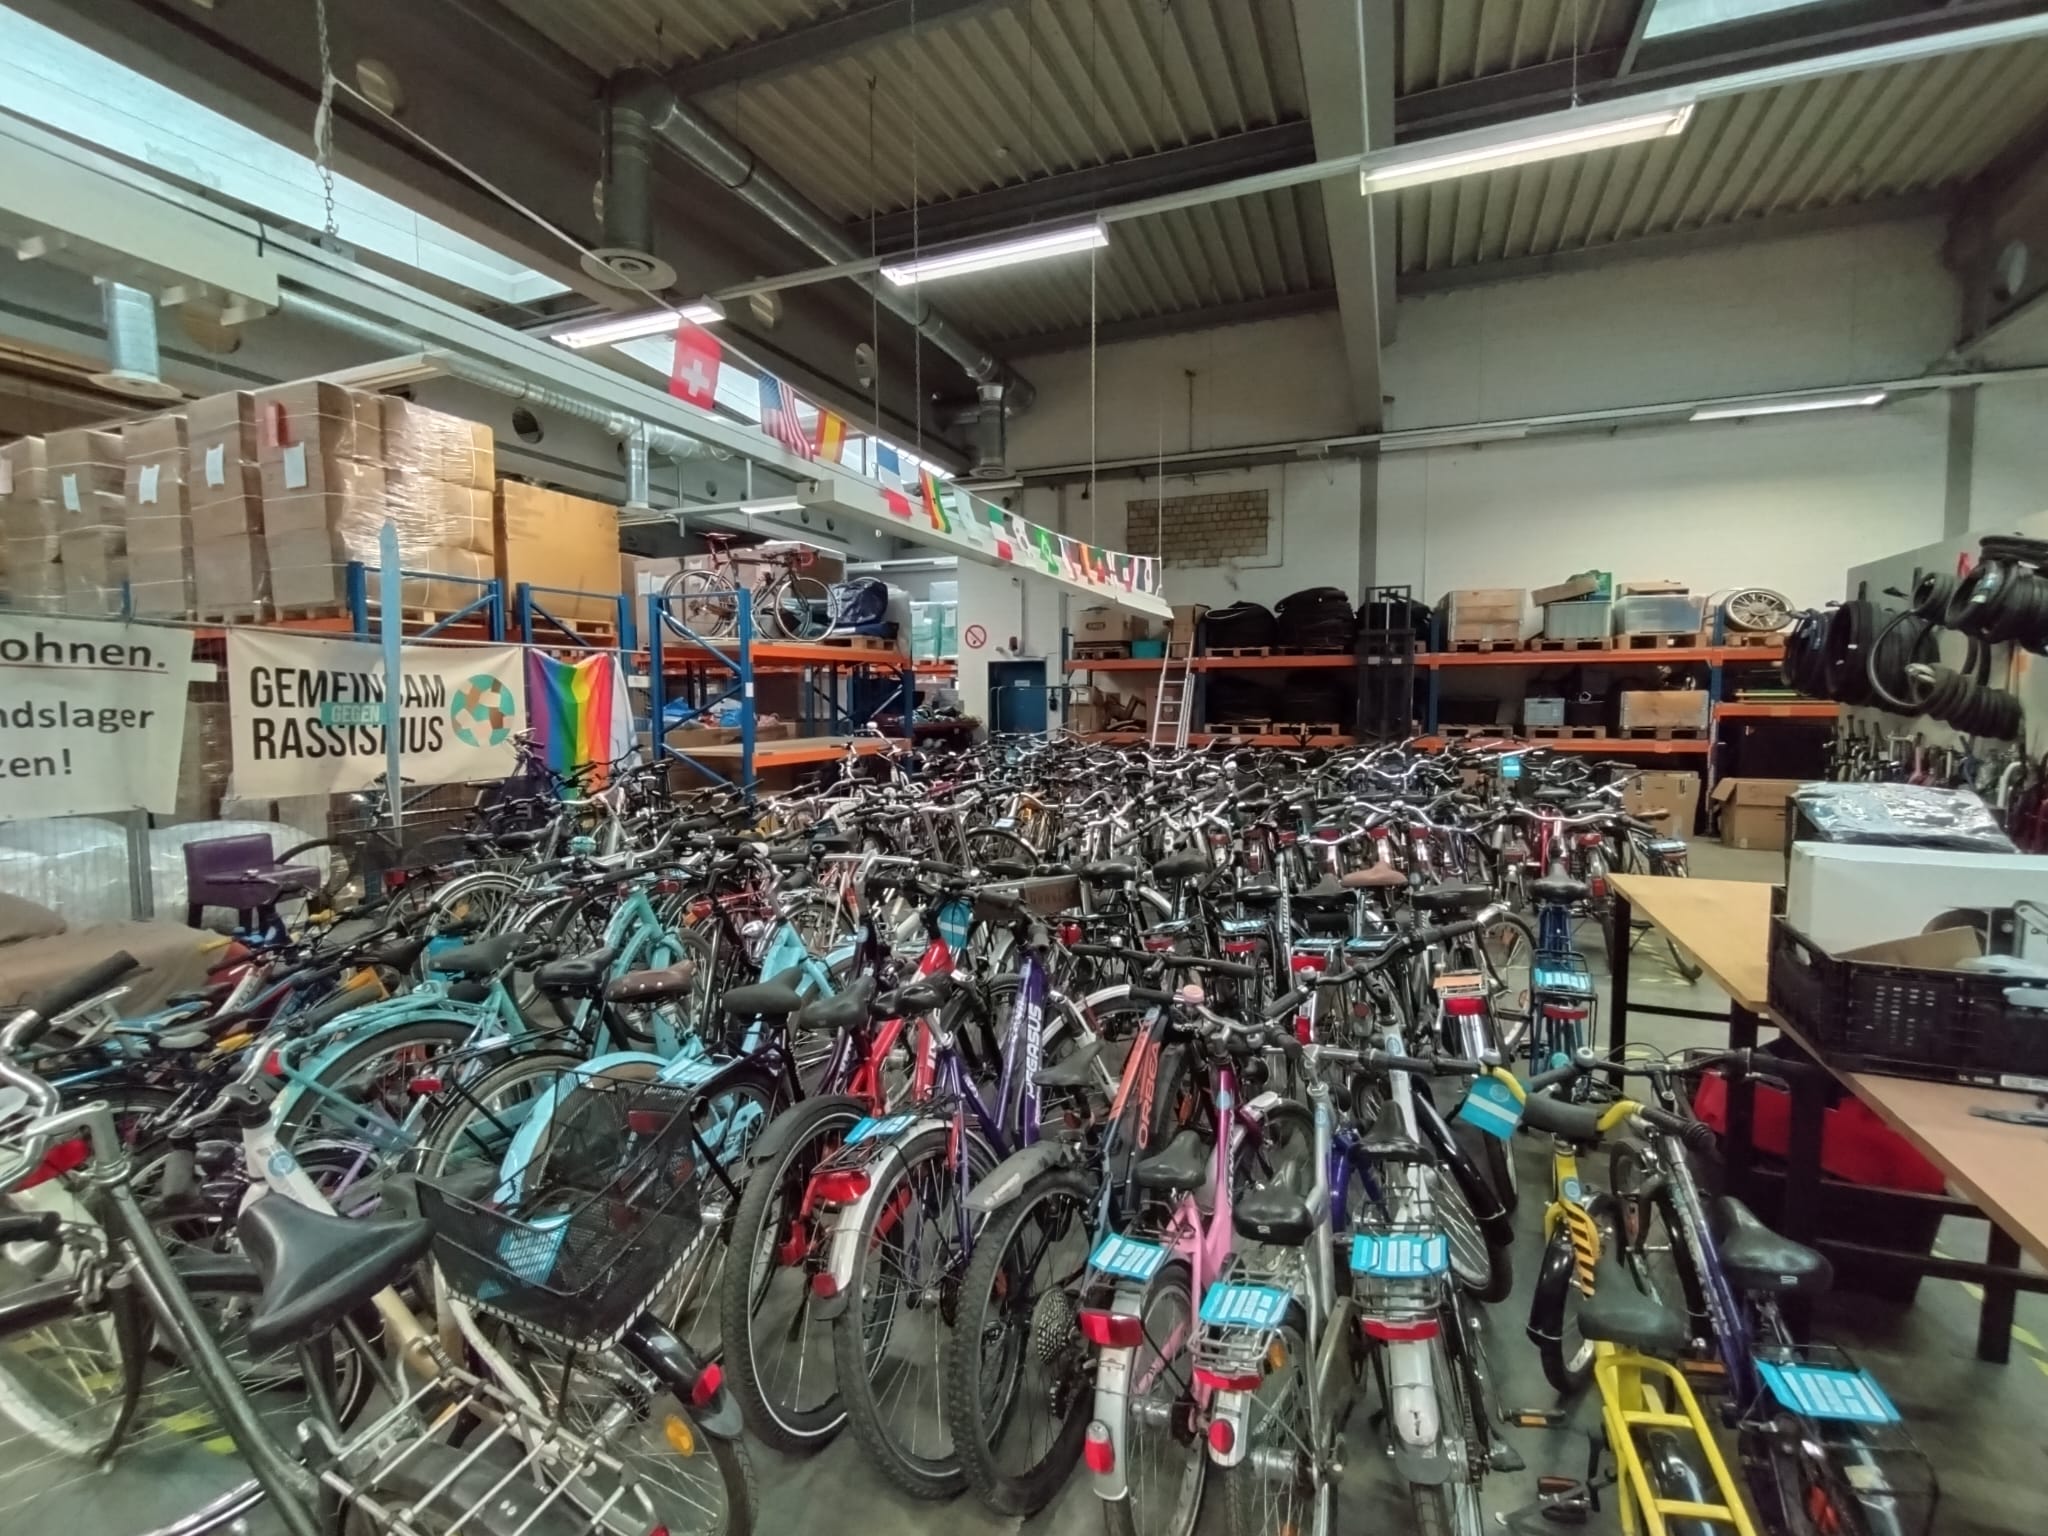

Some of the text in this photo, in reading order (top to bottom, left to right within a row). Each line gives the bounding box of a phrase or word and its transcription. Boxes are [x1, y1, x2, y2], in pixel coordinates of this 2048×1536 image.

[0, 632, 166, 668] ohnen.
[250, 666, 446, 708] GEMEINAM
[330, 705, 381, 723] GEGEN
[1138, 1047, 1159, 1150] ORBEA
